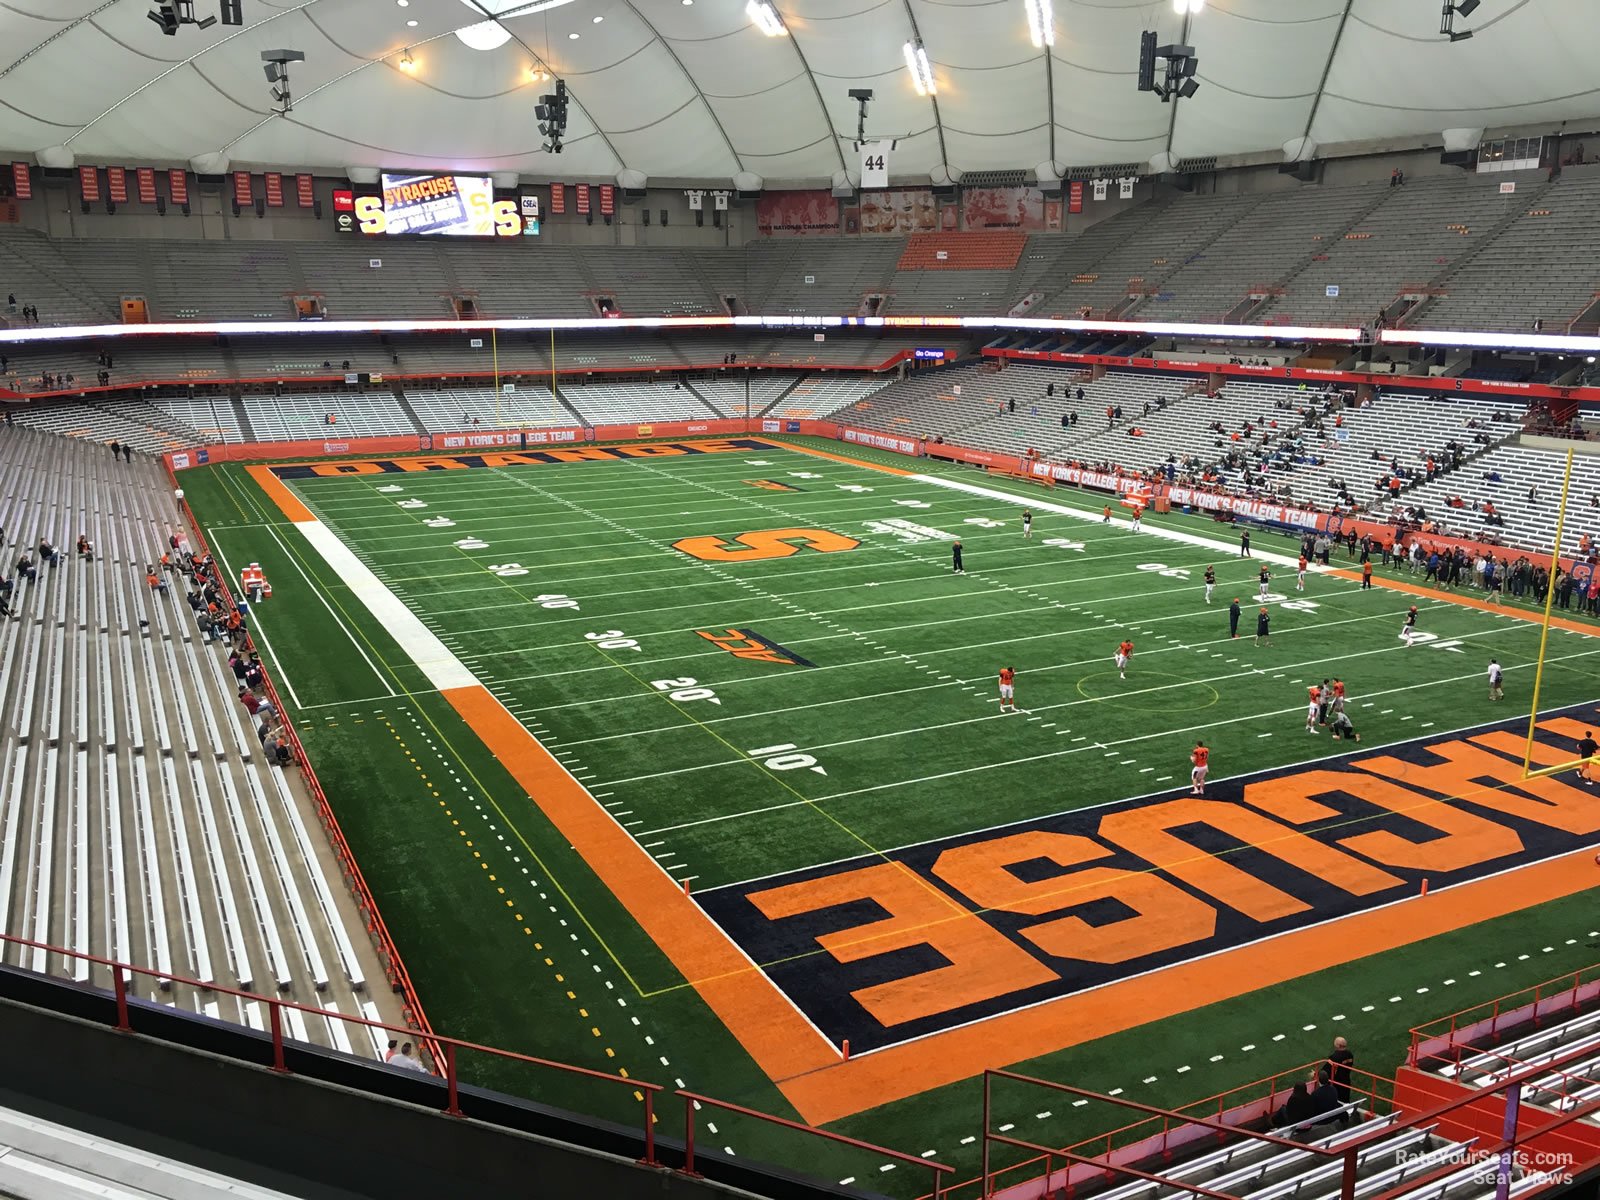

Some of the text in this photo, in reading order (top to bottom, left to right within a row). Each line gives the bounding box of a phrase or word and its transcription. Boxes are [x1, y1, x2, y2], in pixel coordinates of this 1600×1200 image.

[865, 155, 884, 170] 44
[384, 176, 455, 205] SYRACUSE
[1122, 185, 1131, 193] 39
[355, 196, 386, 234] S
[493, 200, 521, 236] S
[1456, 380, 1462, 389] S
[444, 436, 466, 447] NEW
[467, 434, 504, 446] YORK'S
[549, 430, 575, 442] TEAM
[845, 430, 915, 453] NEW YORK'S COLLEGE TEAM
[310, 441, 755, 476] ORANGE
[1033, 462, 1050, 476] NEW
[1051, 466, 1080, 483] YORK'S
[1082, 472, 1119, 490] COLLEGE
[1168, 487, 1318, 529] NEW YORK'S COLLEGE TEAM
[671, 528, 863, 562] S
[533, 594, 578, 609] 40
[584, 630, 638, 650] 30
[694, 629, 798, 666] ACC
[650, 677, 716, 702] 20
[747, 743, 818, 772] 10
